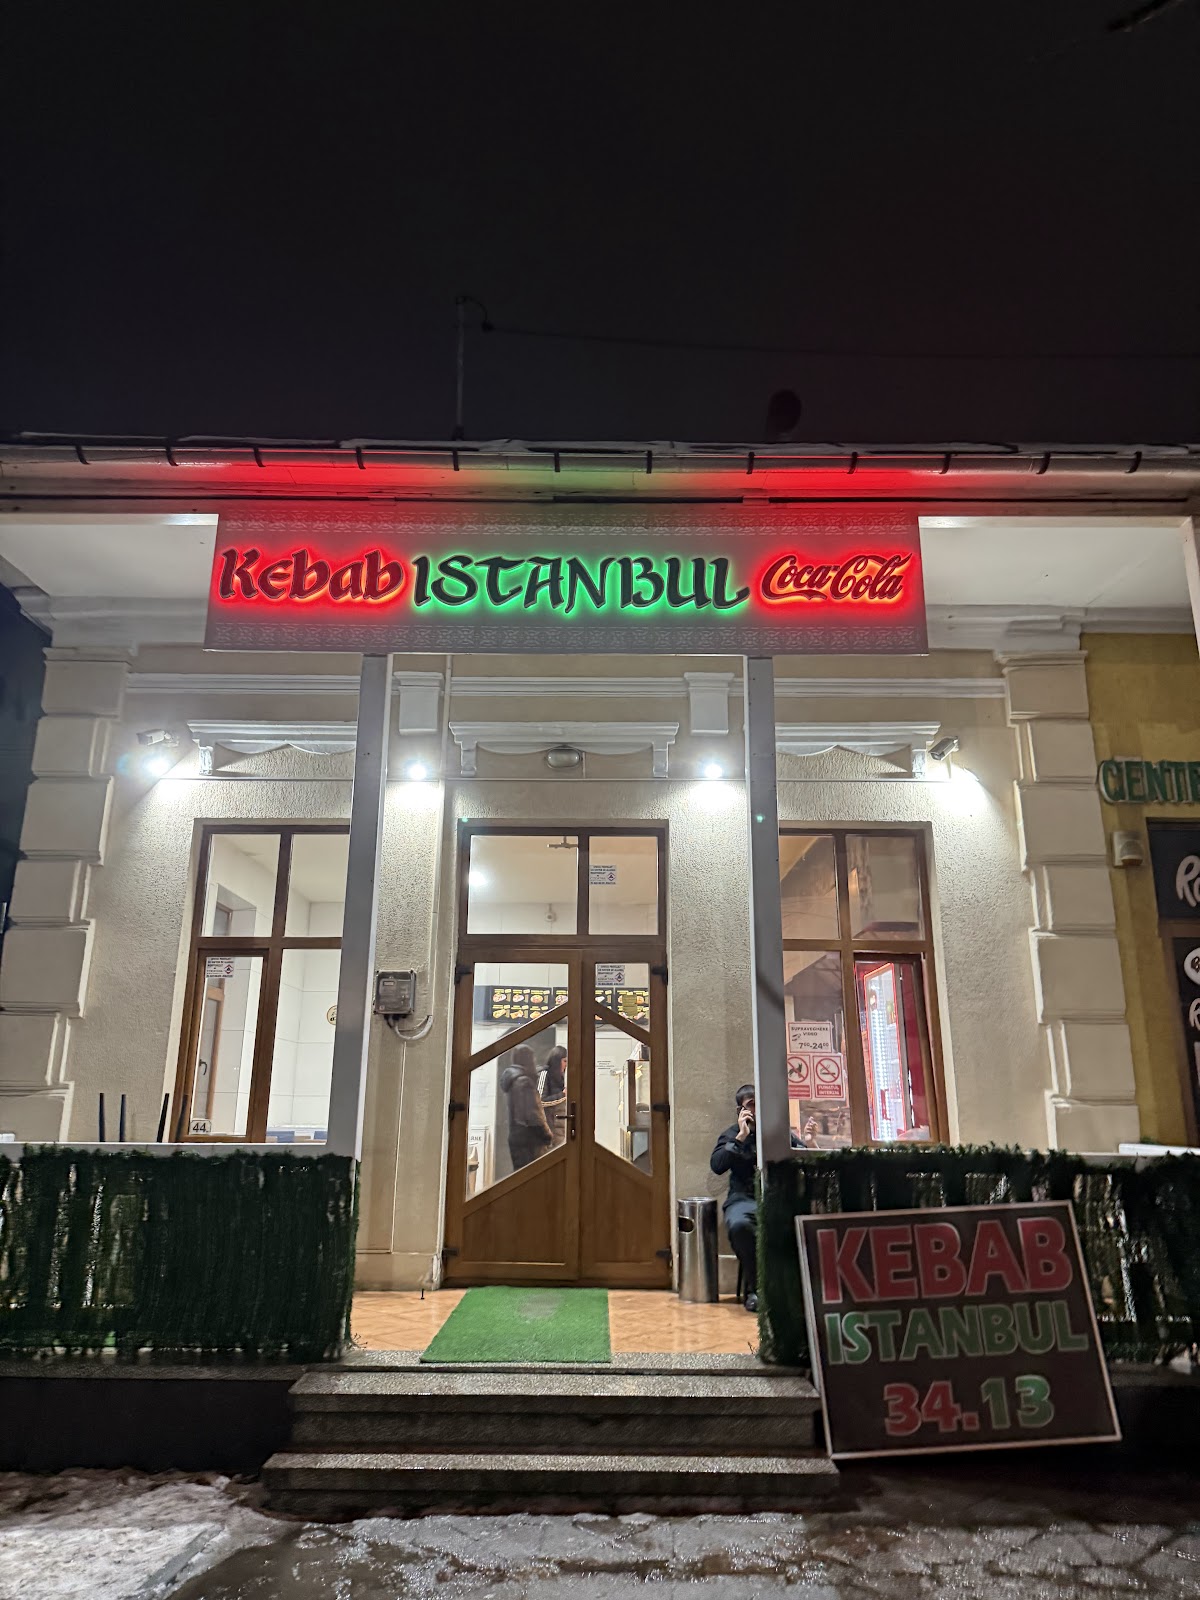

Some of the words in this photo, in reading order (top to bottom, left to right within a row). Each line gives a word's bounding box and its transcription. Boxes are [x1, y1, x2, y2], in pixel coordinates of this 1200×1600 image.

[219, 548, 404, 600] Kebab
[411, 554, 751, 613] ISTANBUL
[761, 552, 913, 600] Coca-Cola
[816, 1216, 1074, 1305] KEBAB
[824, 1299, 1090, 1366] ISTANBUL
[883, 1373, 1055, 1437] 34.13
